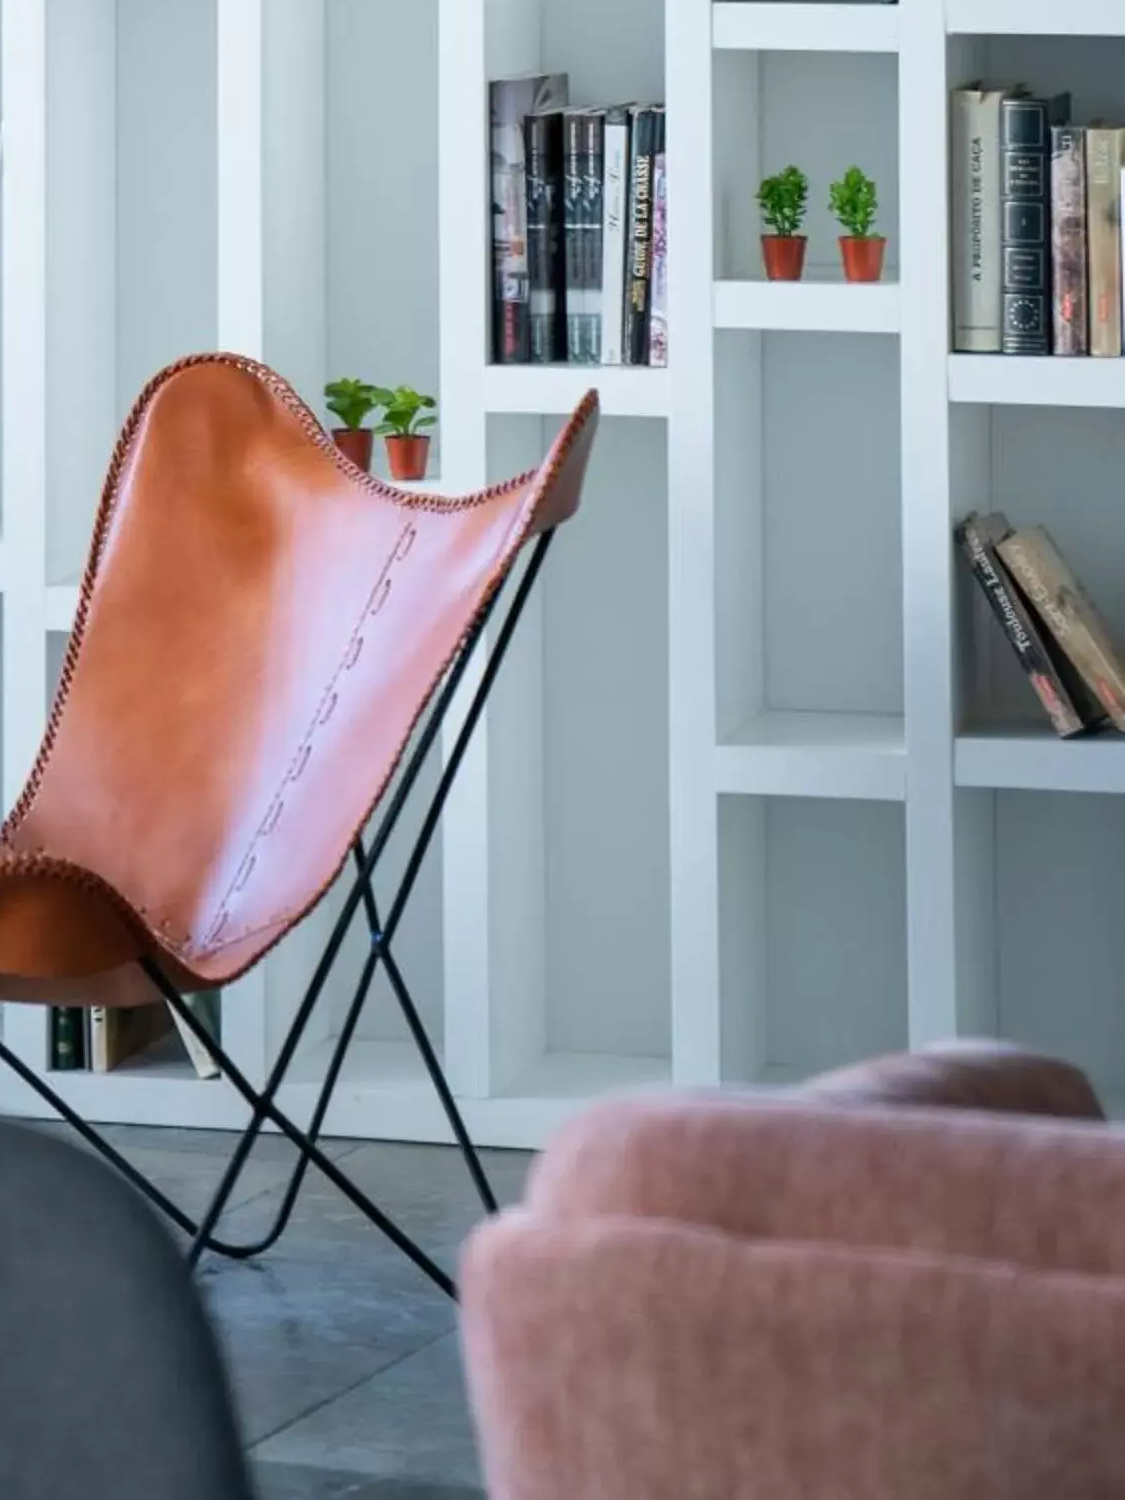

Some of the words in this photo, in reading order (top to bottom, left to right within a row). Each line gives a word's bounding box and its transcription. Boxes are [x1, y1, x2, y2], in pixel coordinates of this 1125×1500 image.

[971, 137, 984, 173] CAÇA
[636, 155, 650, 200] CHASSE
[971, 176, 981, 193] DE
[635, 202, 648, 219] LA
[995, 585, 1031, 652] Toulouse
